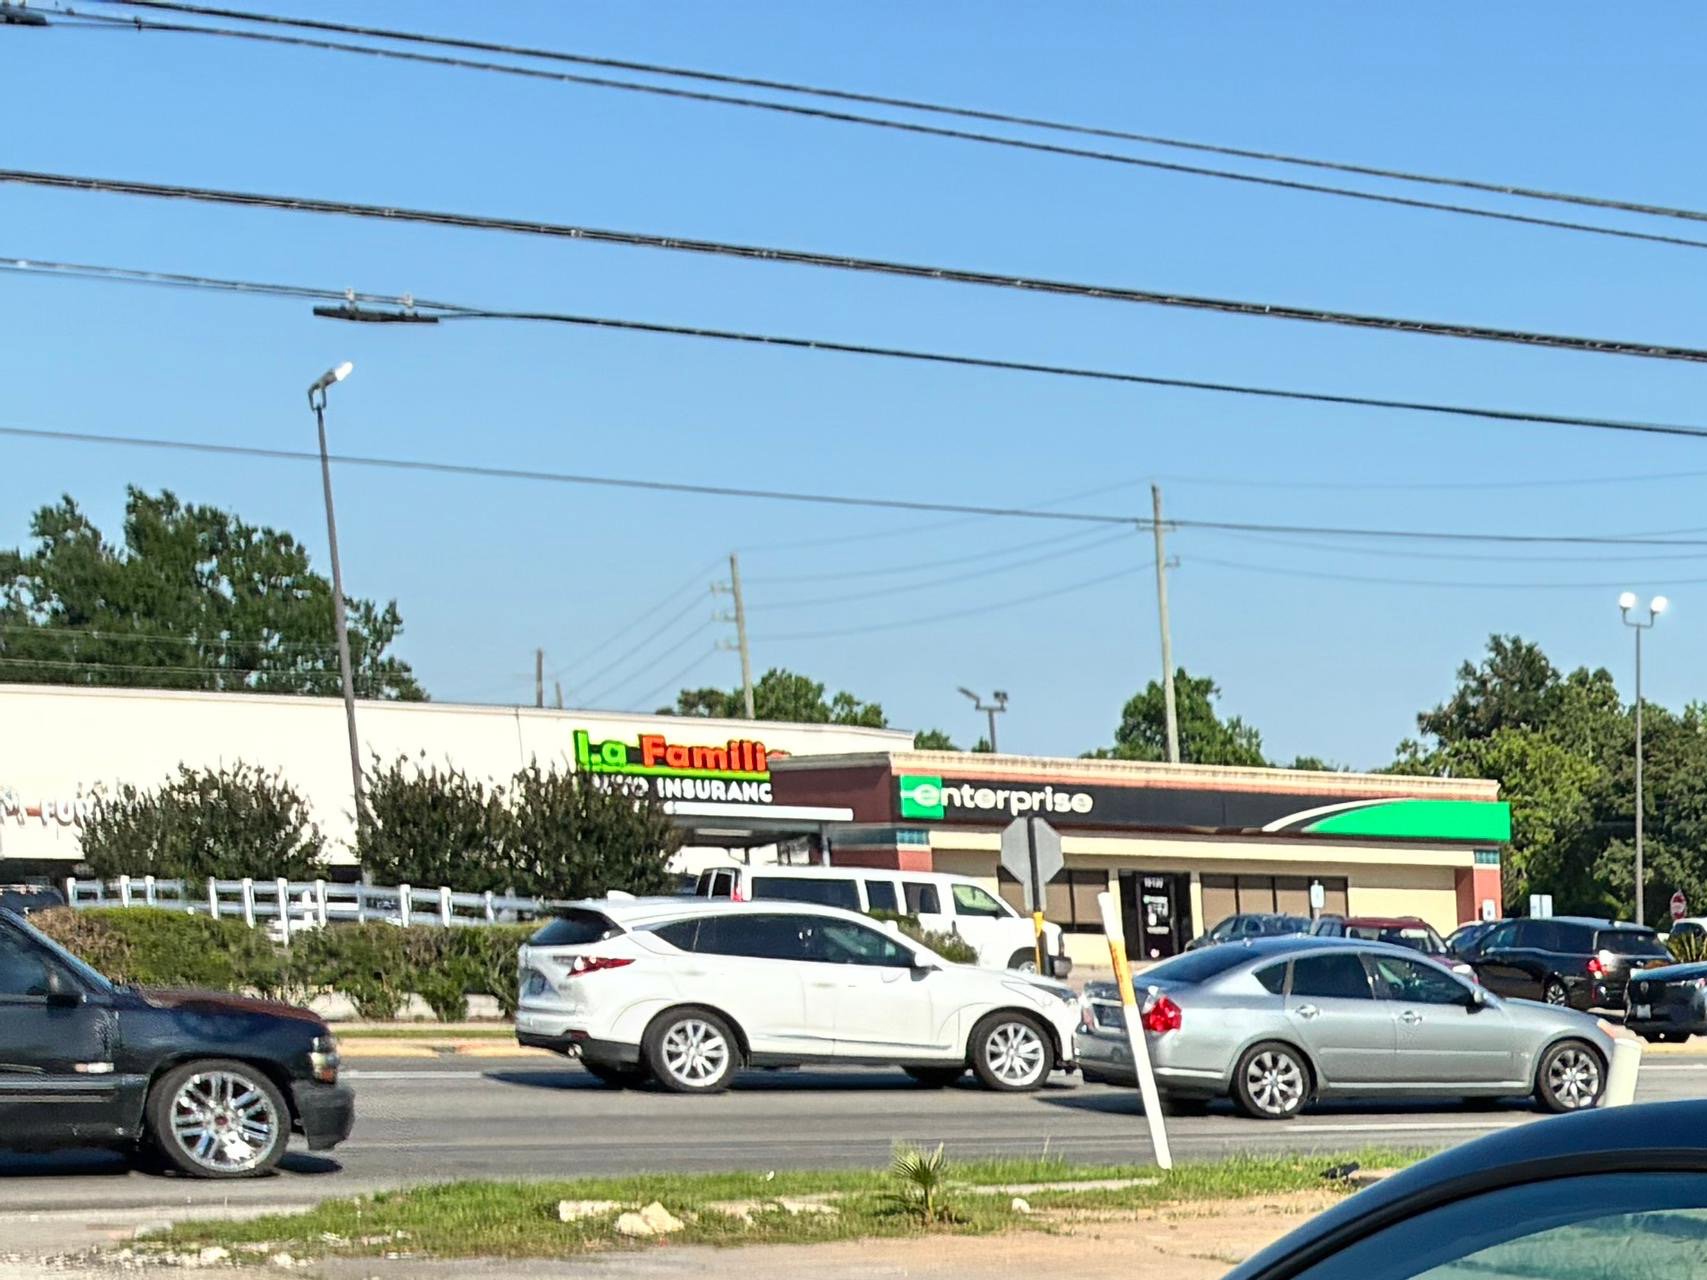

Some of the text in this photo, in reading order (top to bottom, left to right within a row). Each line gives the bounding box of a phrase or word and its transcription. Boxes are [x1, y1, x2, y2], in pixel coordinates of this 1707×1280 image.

[573, 730, 792, 772] La Famili
[910, 783, 1094, 817] enterprise
